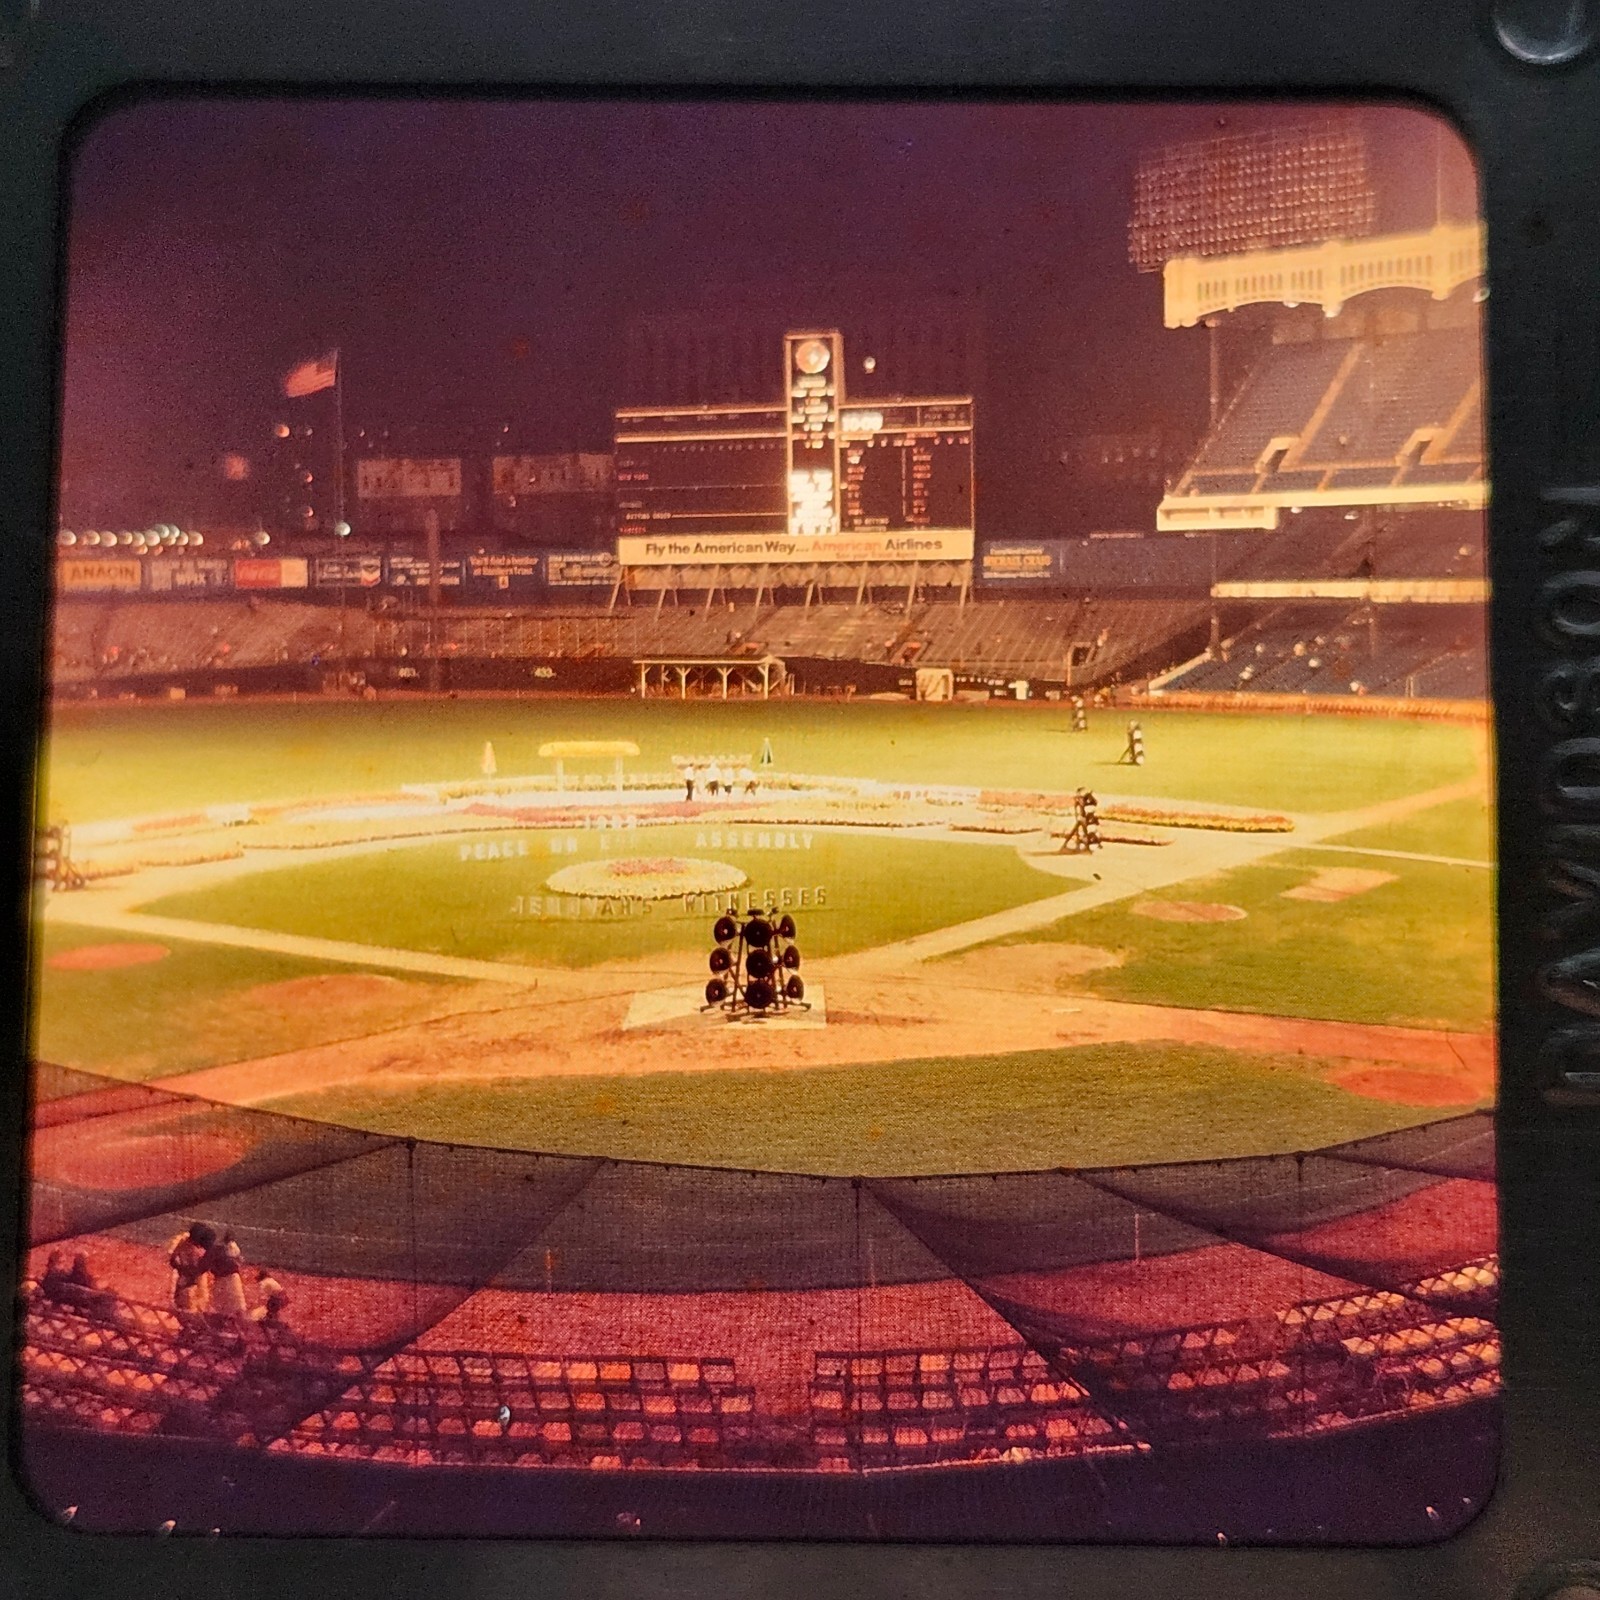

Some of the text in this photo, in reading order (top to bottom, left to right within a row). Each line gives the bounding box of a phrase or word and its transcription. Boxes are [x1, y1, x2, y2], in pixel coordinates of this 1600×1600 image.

[646, 543, 665, 556] Fly
[669, 542, 690, 554] the
[693, 542, 763, 554] American
[812, 540, 881, 552] American
[885, 538, 943, 551] Airlines
[71, 567, 135, 580] ANACIN
[460, 837, 577, 861] PEACE ON
[695, 831, 813, 849] ASSEMBLY
[684, 885, 827, 913] WITNESSES
